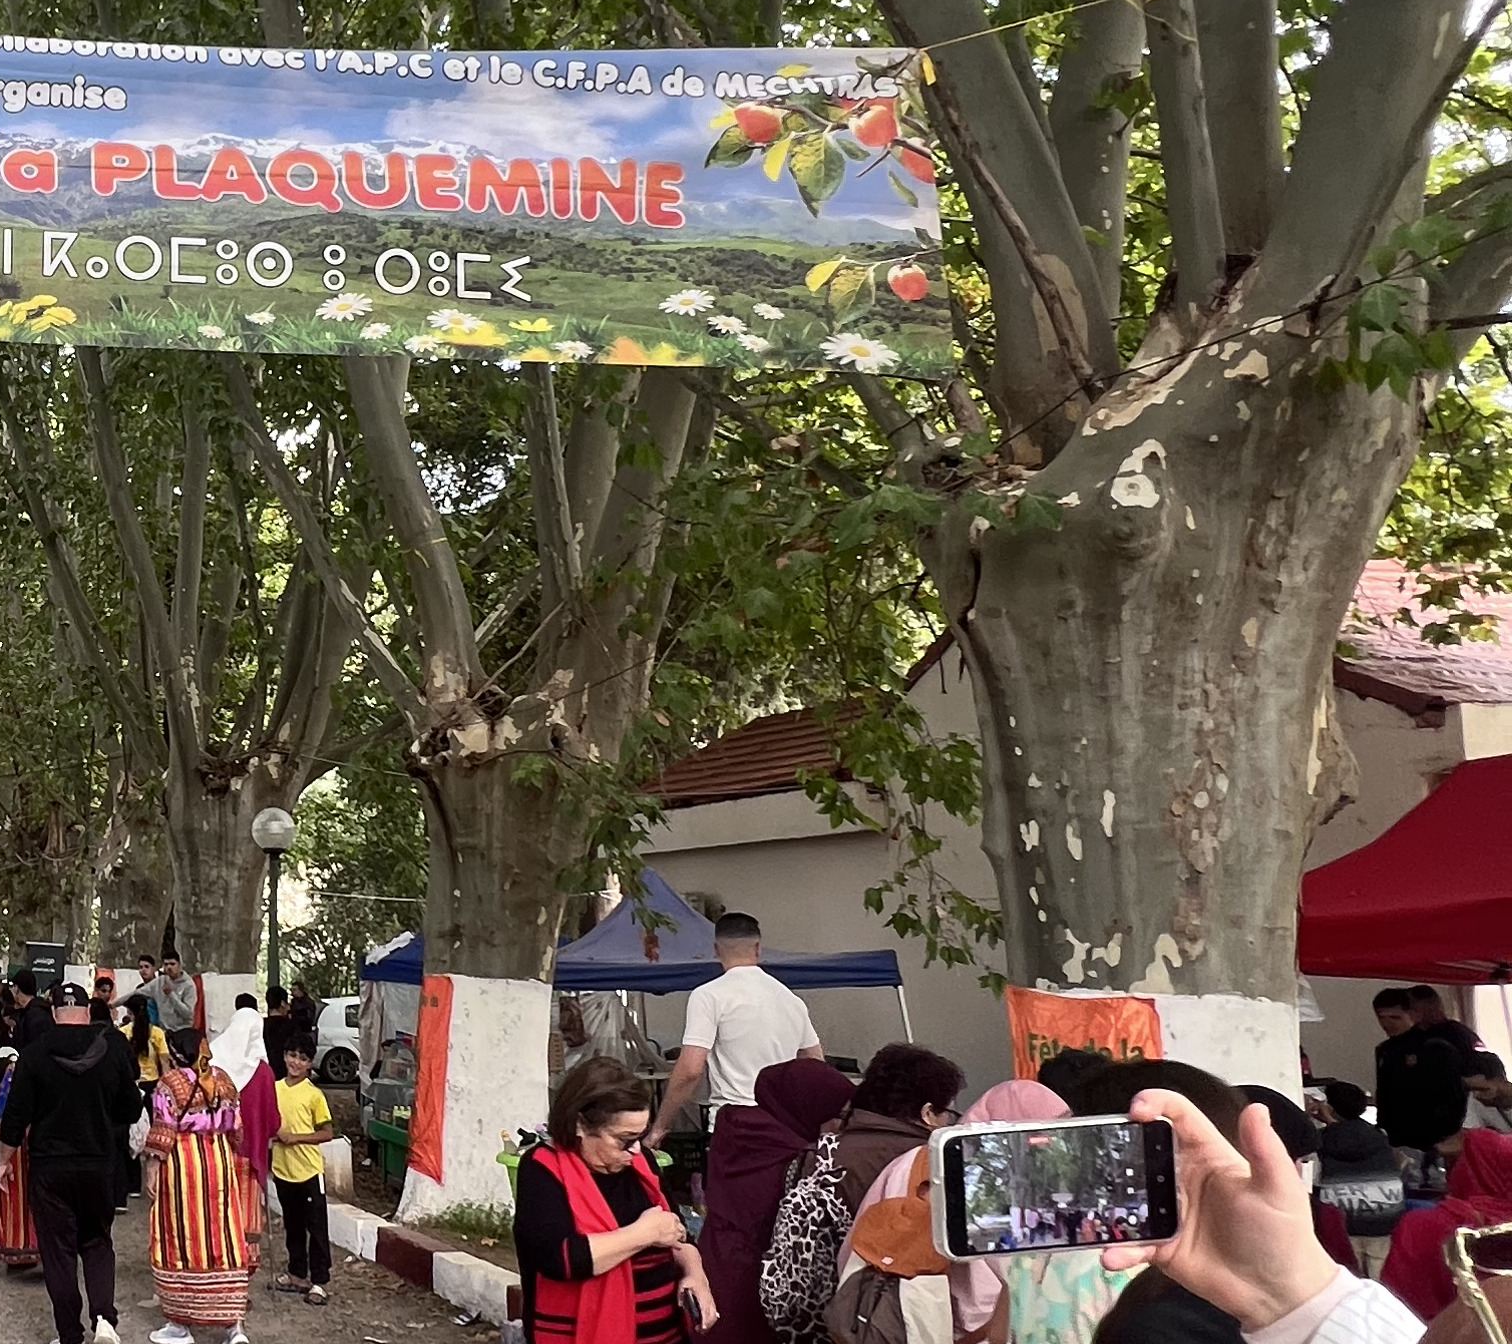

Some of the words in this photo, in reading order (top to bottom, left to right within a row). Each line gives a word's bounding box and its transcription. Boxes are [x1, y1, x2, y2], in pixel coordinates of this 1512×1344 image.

[218, 49, 307, 70] avec
[442, 55, 482, 83] et
[488, 55, 524, 86] le
[532, 59, 653, 96] C.F.P.A
[661, 66, 705, 99] de
[715, 71, 899, 100] MECHTRAS
[91, 141, 686, 229] PLAQUEMINE
